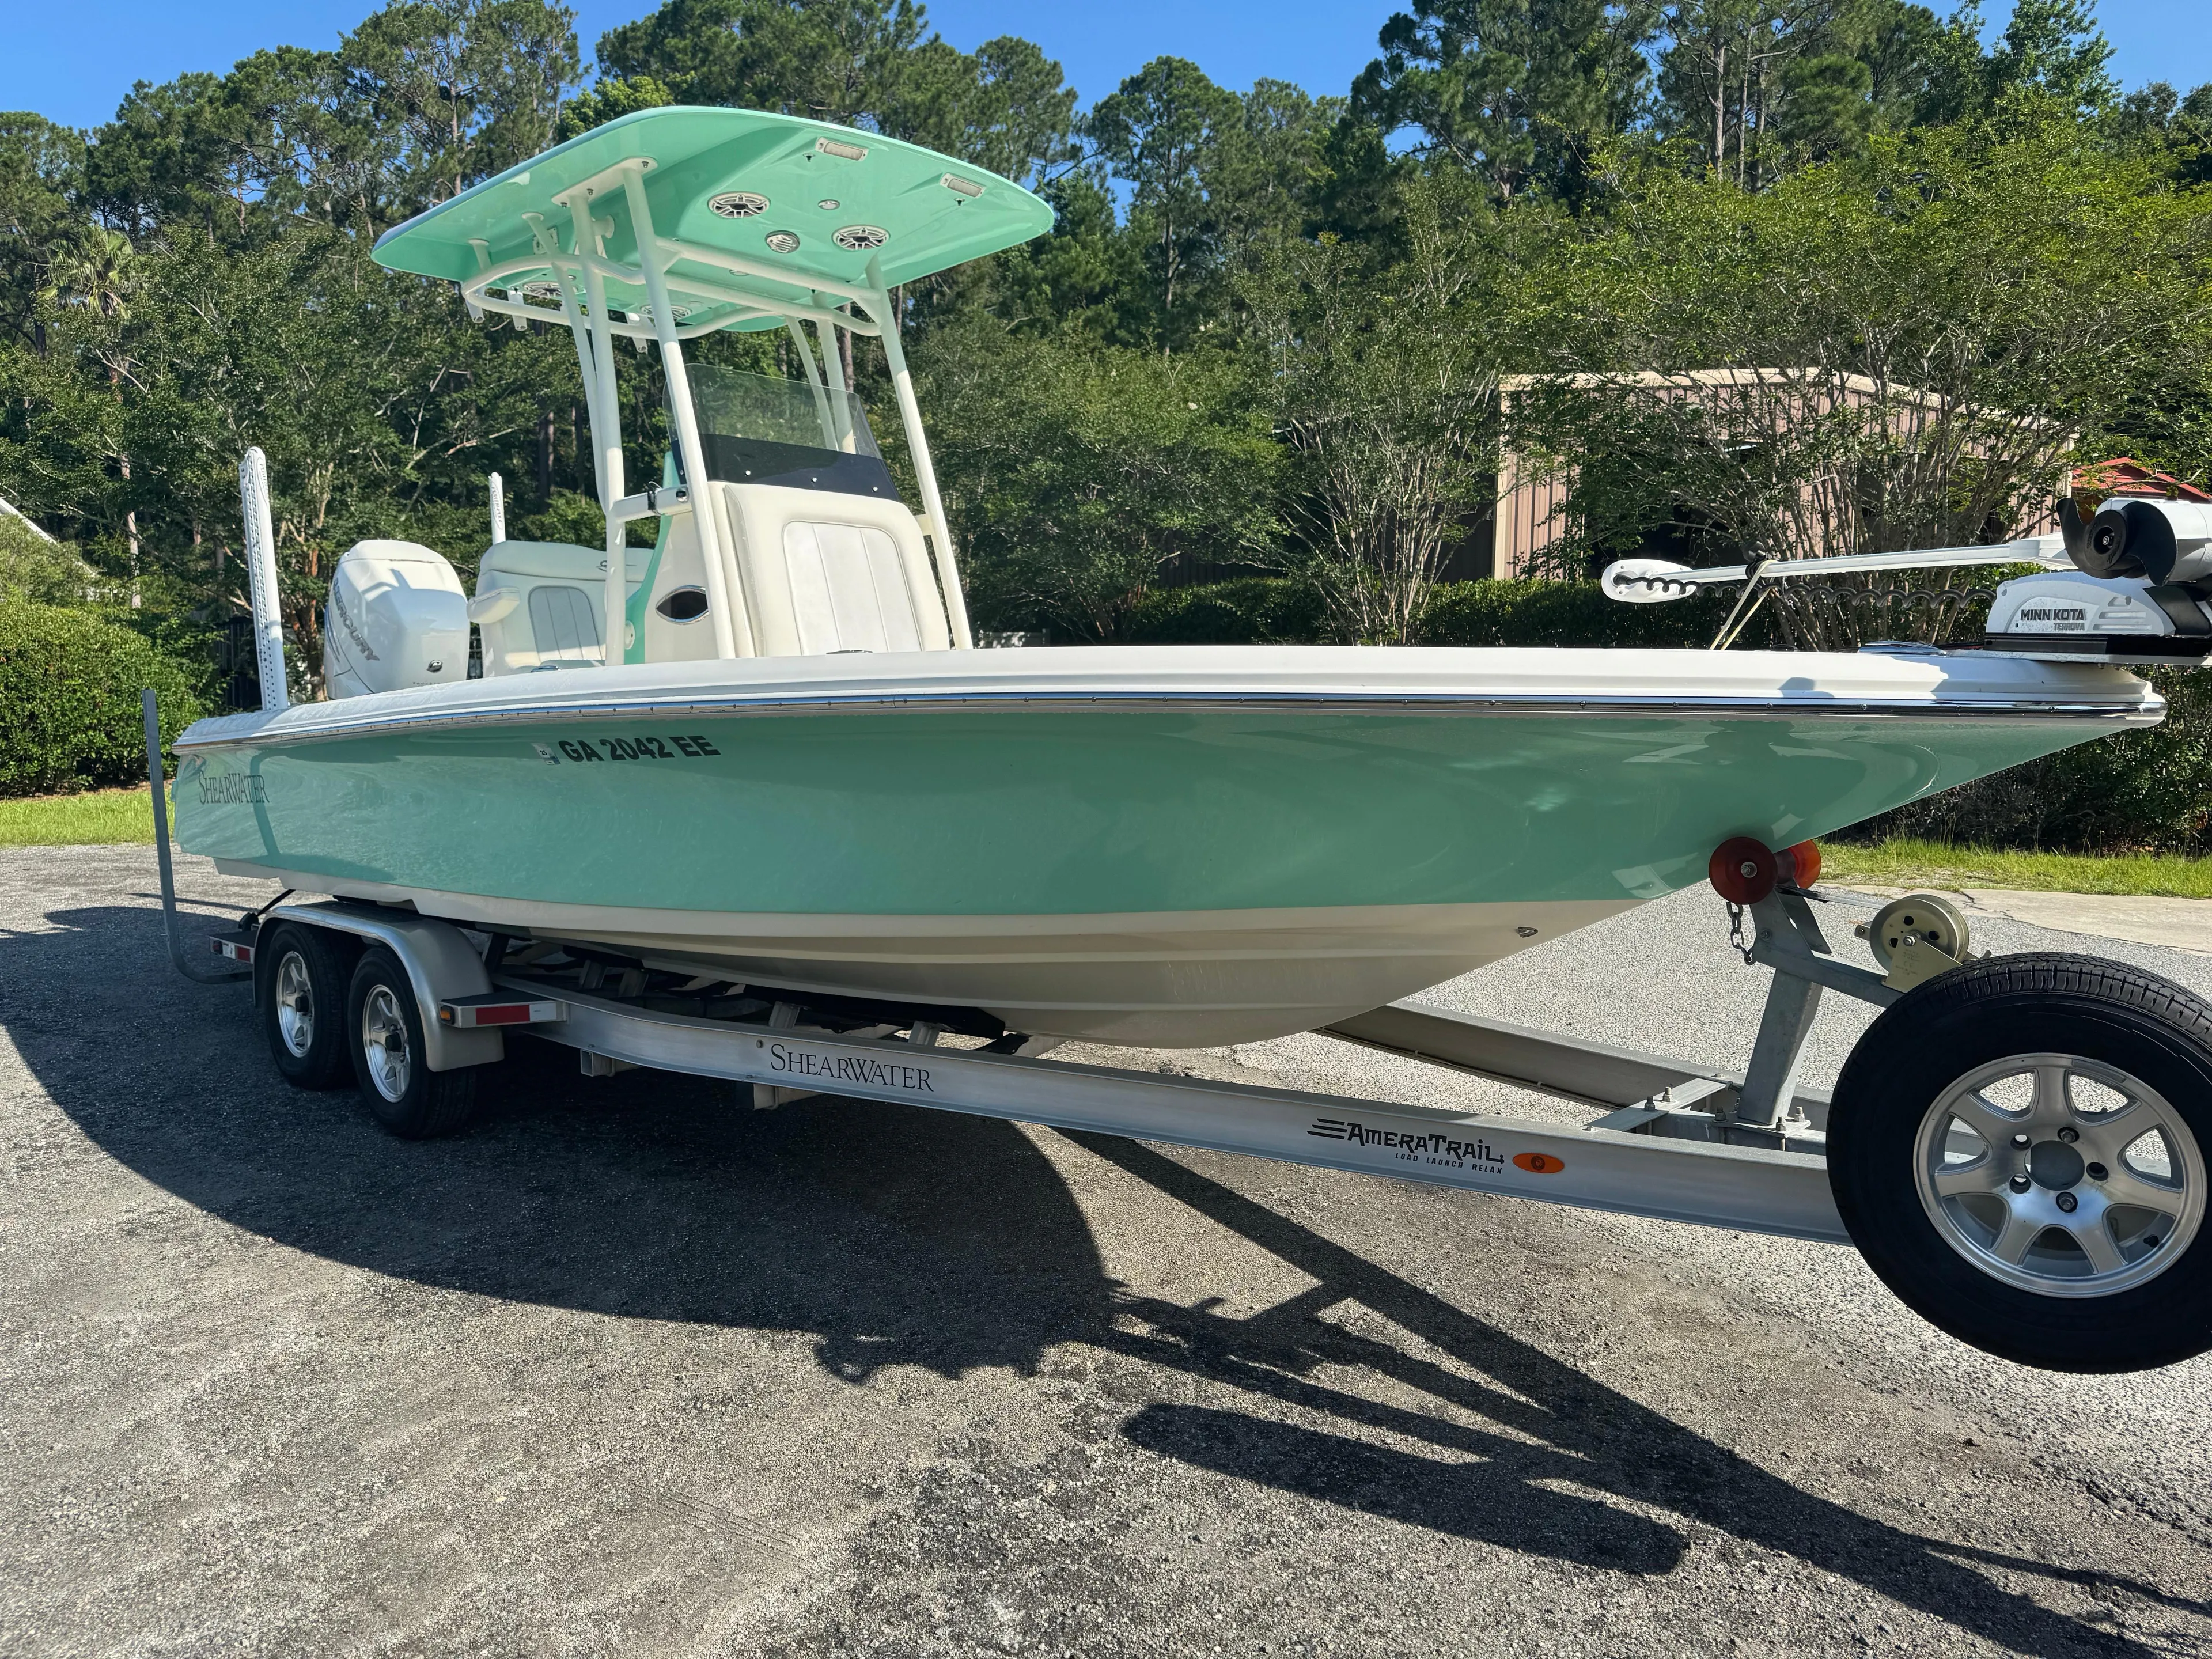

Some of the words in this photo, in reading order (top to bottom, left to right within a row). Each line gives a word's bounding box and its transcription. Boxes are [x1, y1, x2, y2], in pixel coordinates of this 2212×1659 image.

[333, 577, 380, 661] MERCURY
[2020, 609, 2052, 621] MINN
[2052, 609, 2086, 621] KOTA
[558, 740, 604, 762] GA
[599, 737, 675, 760] 2042
[668, 736, 722, 757] EE
[1395, 1152, 1419, 1162] LOAD
[1426, 1157, 1464, 1169] LAUNCH
[1471, 1164, 1503, 1175] RELAX
